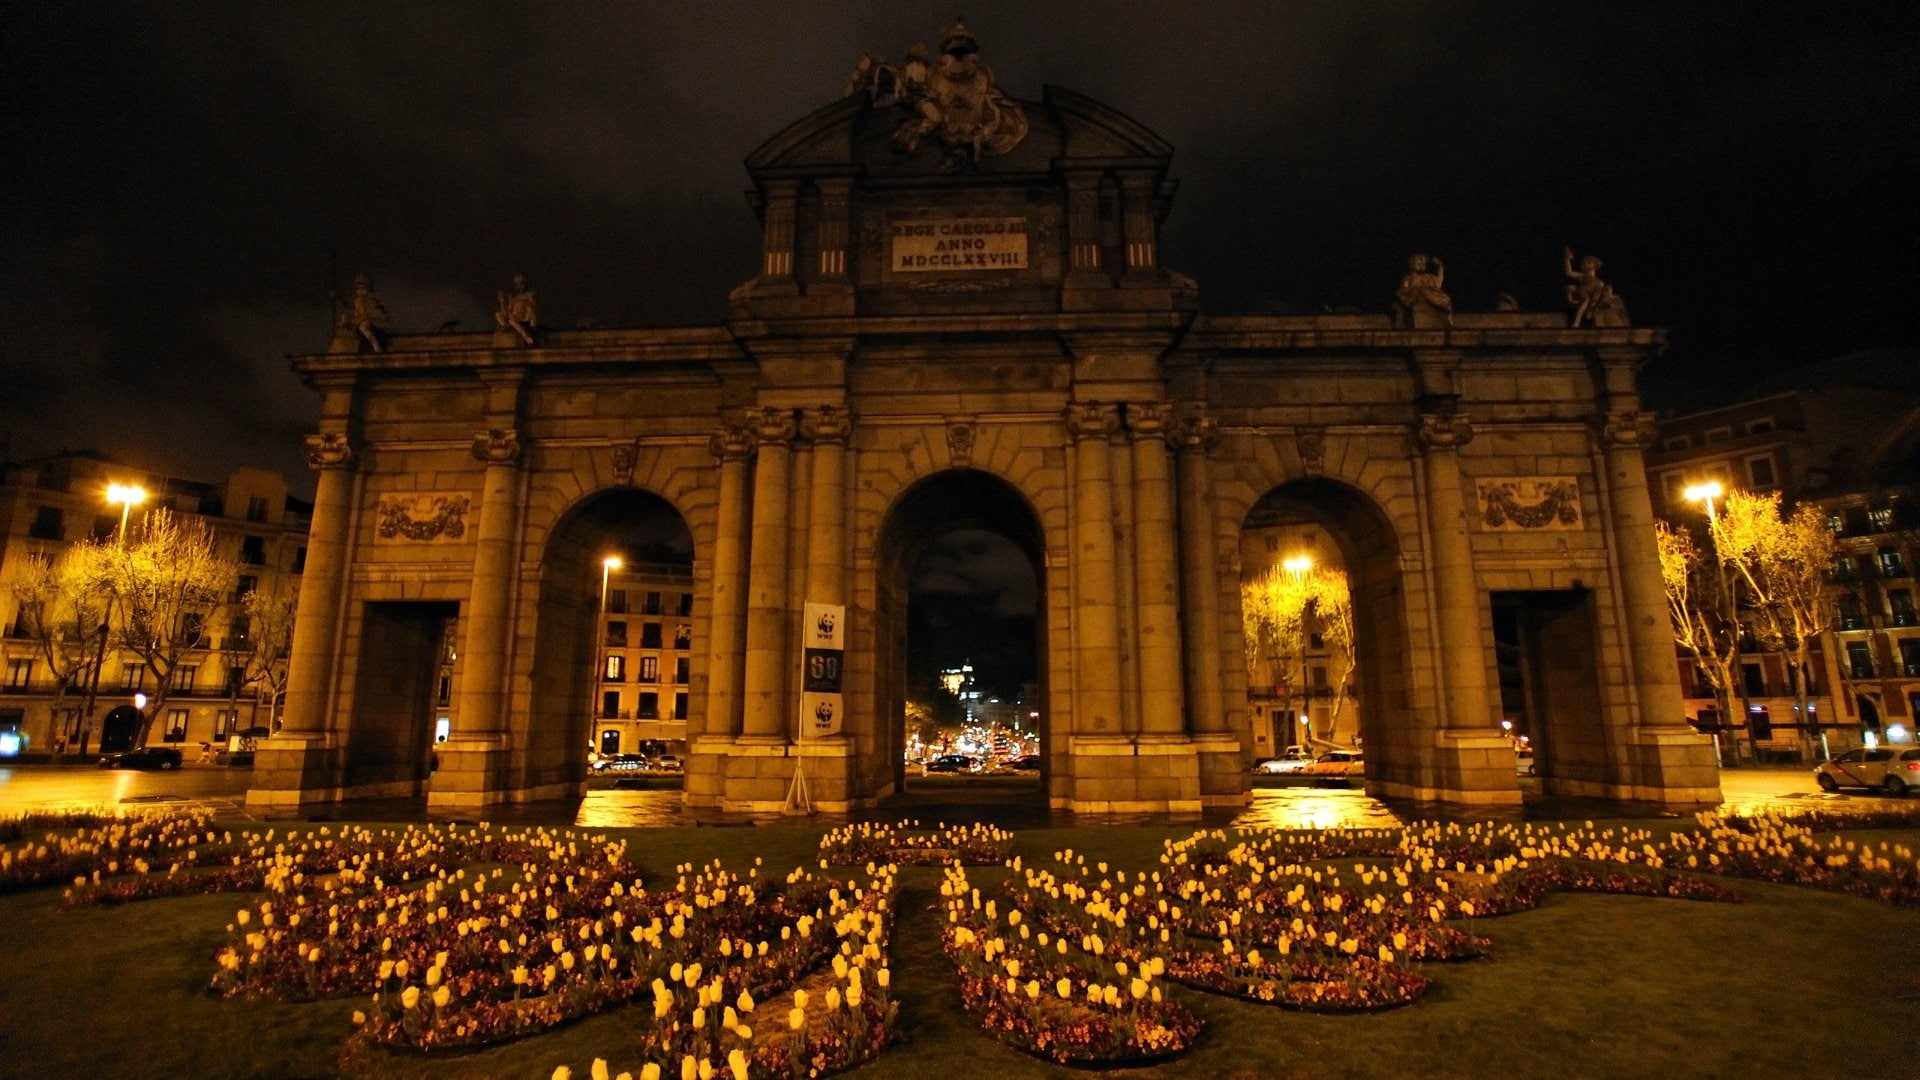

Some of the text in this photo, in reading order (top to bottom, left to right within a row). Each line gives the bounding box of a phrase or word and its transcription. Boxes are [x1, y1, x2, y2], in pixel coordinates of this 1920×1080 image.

[892, 225, 935, 236] REGE
[940, 223, 1005, 235] CAROLO
[936, 238, 985, 251] ANNO
[902, 252, 1019, 267] MDCCLXXVIII
[810, 655, 838, 680] 60
